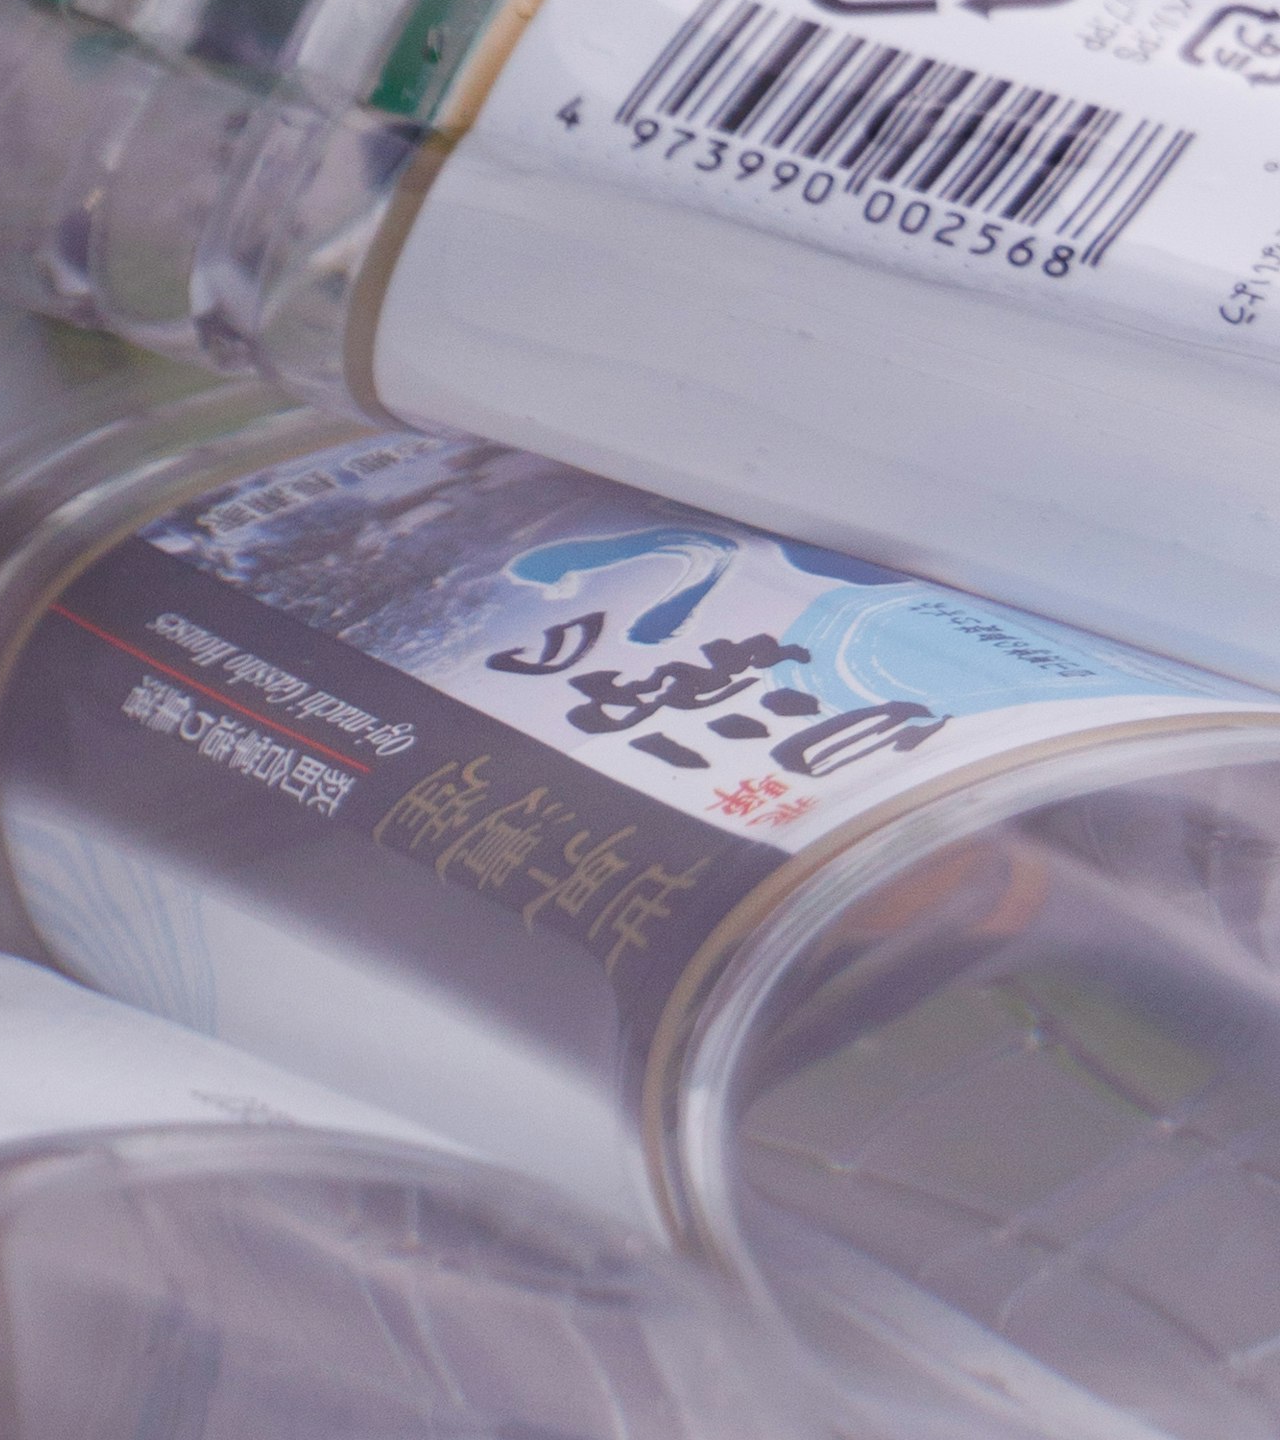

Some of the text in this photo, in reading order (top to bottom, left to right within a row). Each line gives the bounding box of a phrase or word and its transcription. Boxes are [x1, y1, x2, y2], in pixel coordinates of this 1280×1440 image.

[555, 95, 1076, 278] 4 973990 002568
[120, 674, 358, 818] 荻町合掌造り集落
[144, 612, 418, 757] Ogi-machi Gassho Houses
[372, 753, 713, 977] 世界遺産
